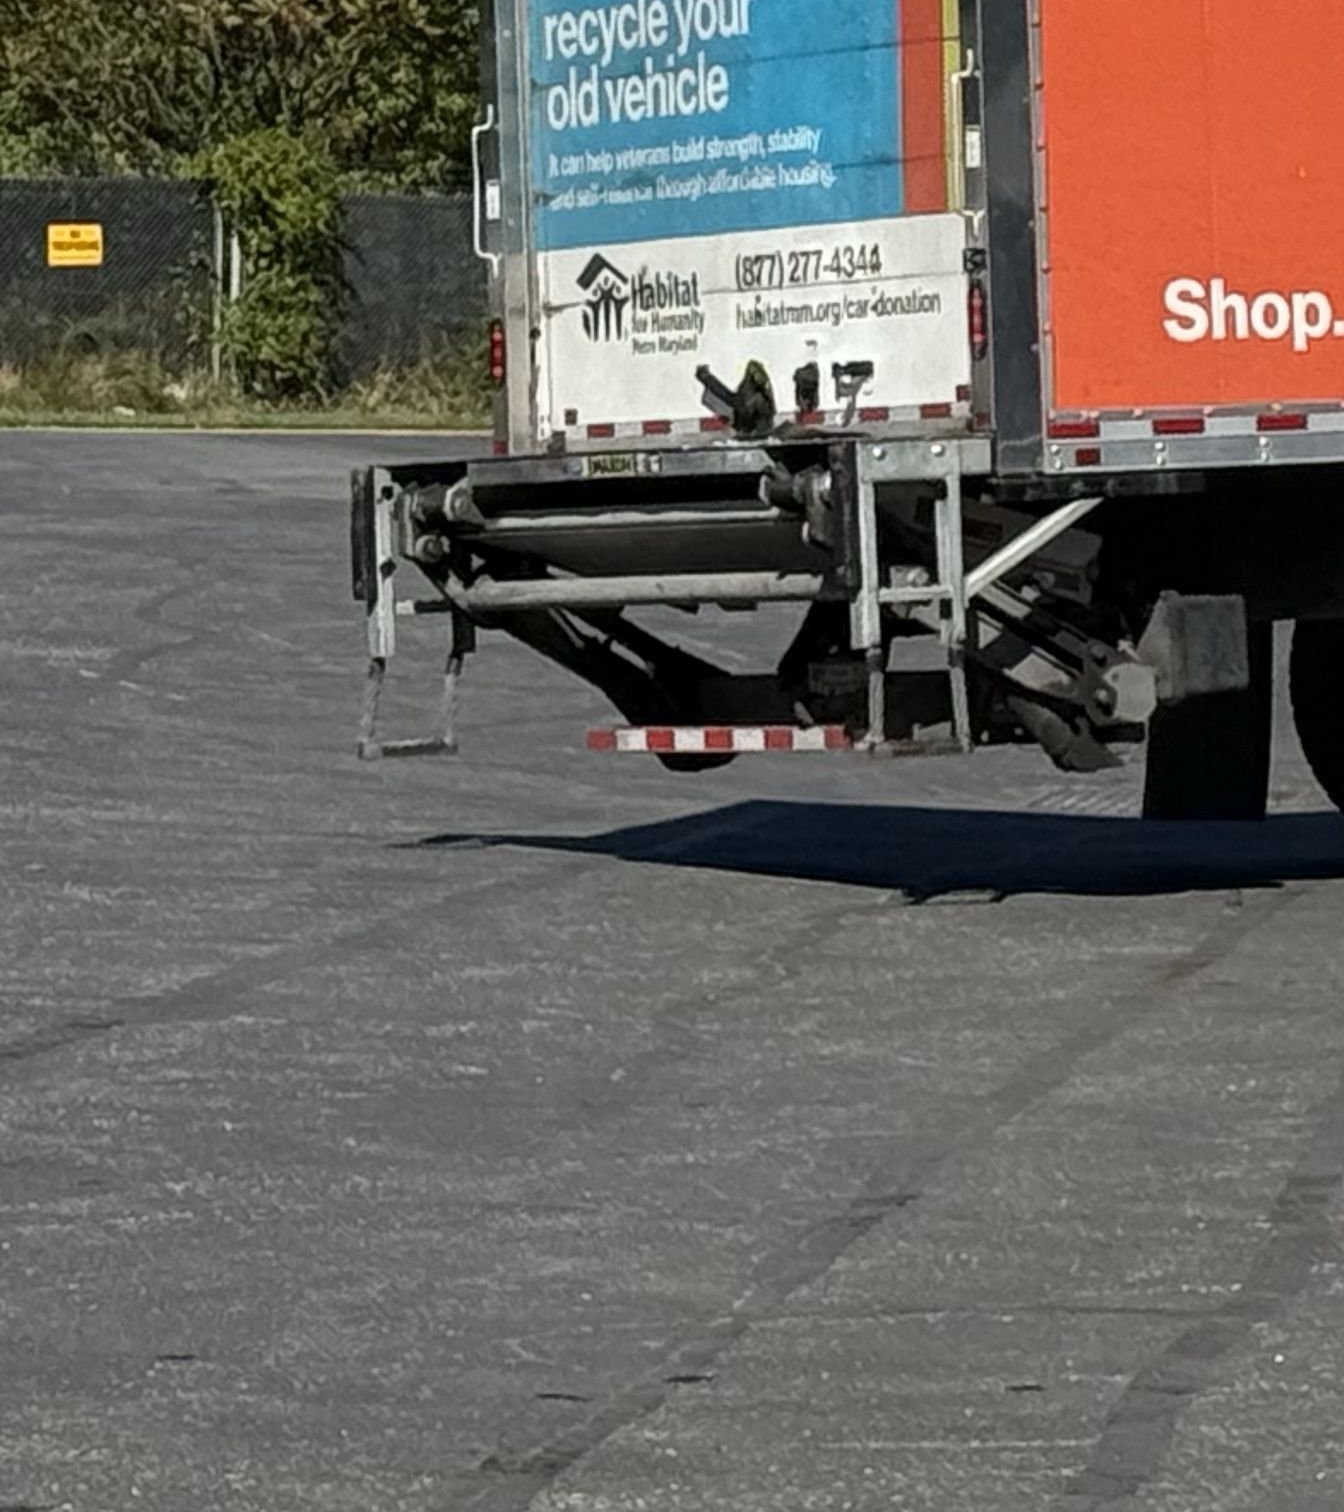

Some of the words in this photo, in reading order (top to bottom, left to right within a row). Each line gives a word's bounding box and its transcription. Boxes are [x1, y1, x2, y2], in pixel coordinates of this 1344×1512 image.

[547, 65, 598, 130] old
[604, 52, 729, 122] vehicle
[560, 154, 585, 176] can
[585, 148, 613, 175] help
[615, 146, 670, 172] veterans
[672, 136, 704, 163] build
[767, 125, 821, 155] stability
[631, 270, 700, 312] Habitat
[735, 250, 784, 292] (877)
[787, 243, 882, 284] 277-4344
